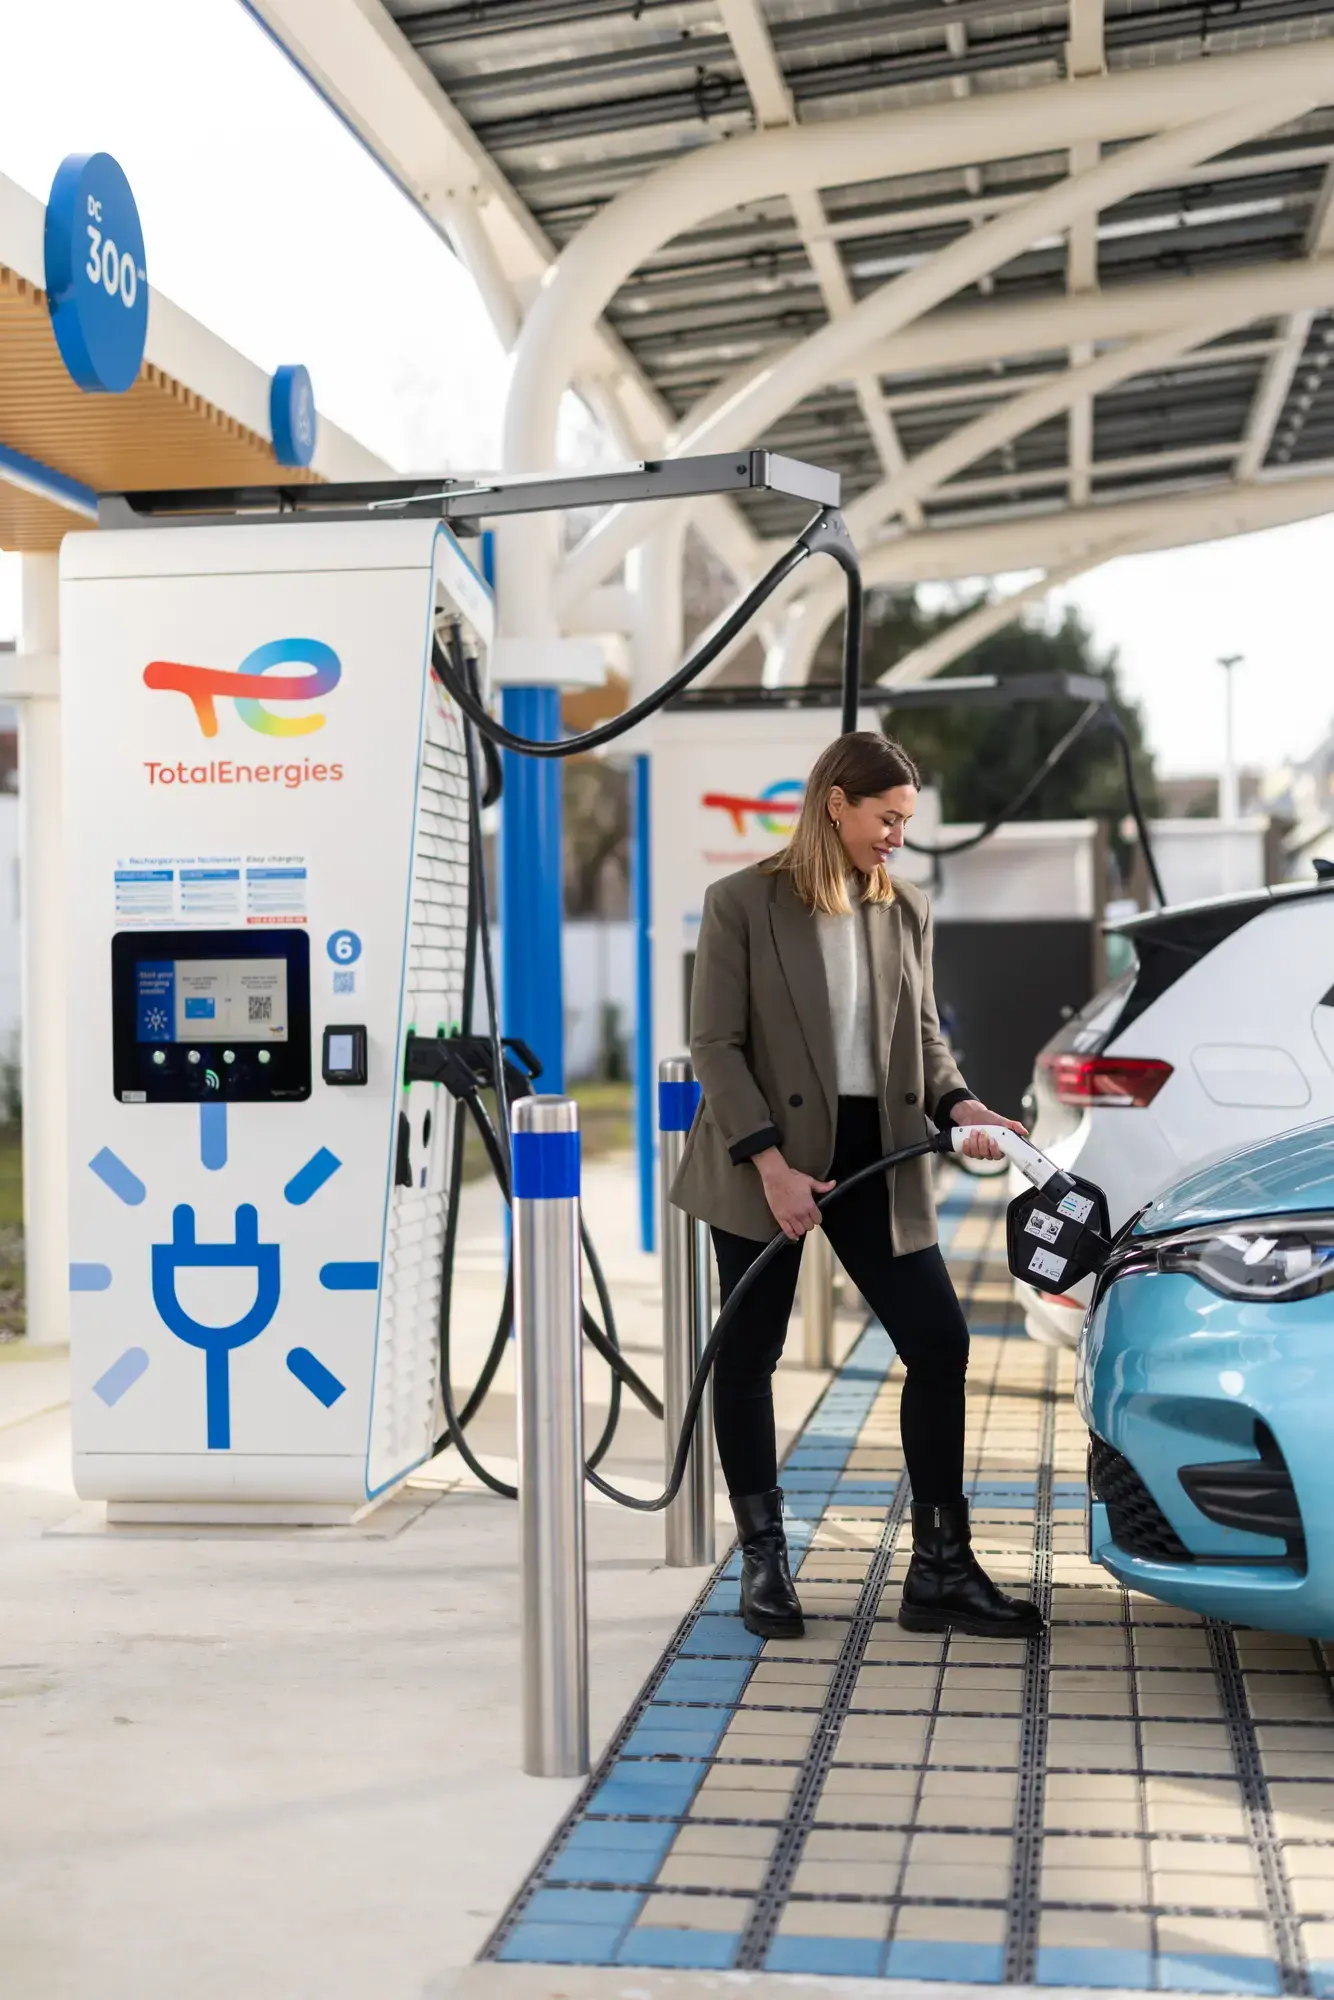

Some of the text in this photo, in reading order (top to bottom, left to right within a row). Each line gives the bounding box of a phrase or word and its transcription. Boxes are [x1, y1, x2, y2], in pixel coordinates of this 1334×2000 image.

[87, 194, 102, 222] DC
[86, 224, 137, 308] 300
[143, 757, 344, 788] TotalEnergies
[335, 936, 353, 959] 6
